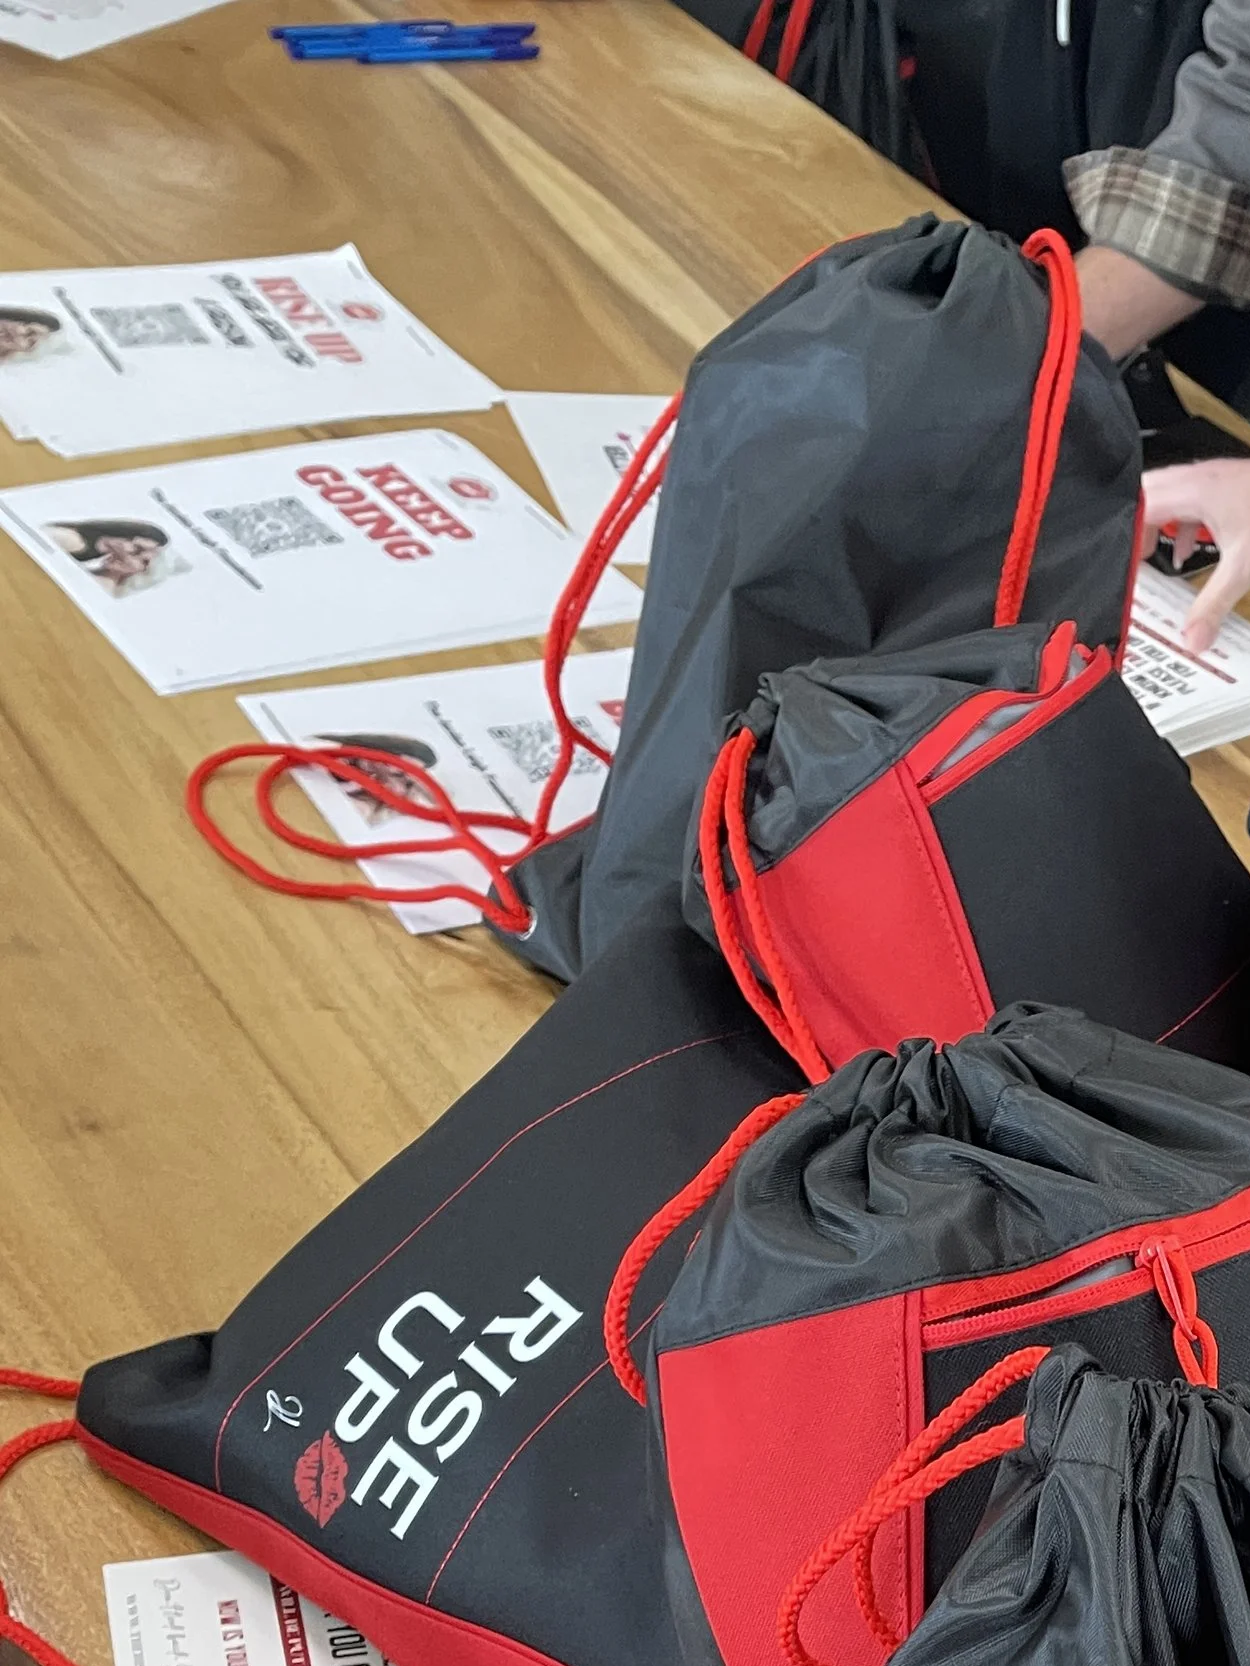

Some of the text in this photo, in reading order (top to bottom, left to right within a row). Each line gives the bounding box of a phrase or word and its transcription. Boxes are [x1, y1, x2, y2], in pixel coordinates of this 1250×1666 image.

[296, 465, 434, 560] GOING
[355, 463, 474, 540] KEEP
[334, 1291, 466, 1443] UP
[351, 1275, 583, 1539] RISE
[327, 1622, 368, 1660] YOU
